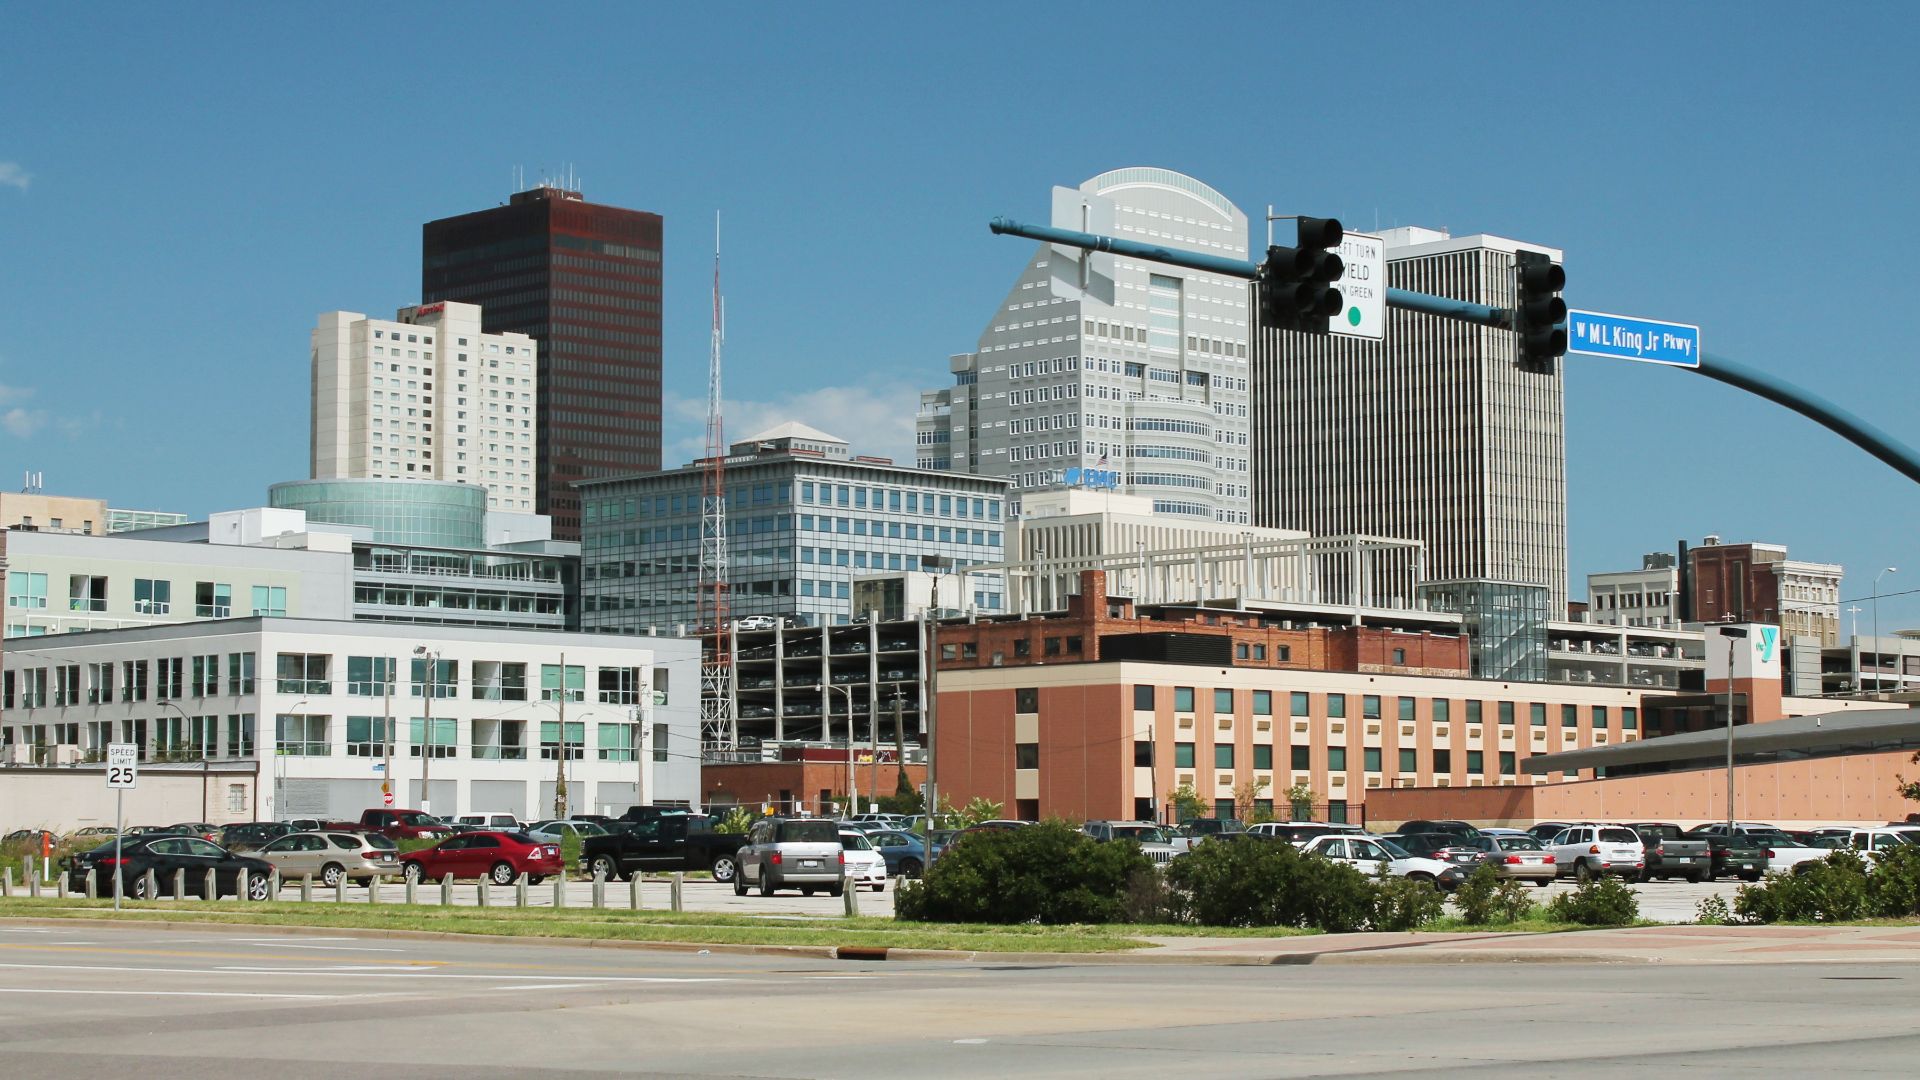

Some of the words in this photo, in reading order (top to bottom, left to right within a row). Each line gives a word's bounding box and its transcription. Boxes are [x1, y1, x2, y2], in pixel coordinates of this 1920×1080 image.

[1356, 243, 1376, 259] TURN
[1350, 285, 1373, 299] GREEN
[1576, 321, 1586, 338] W
[1613, 326, 1642, 356] King
[1645, 330, 1659, 352] Jr
[1663, 333, 1691, 357] Pkwy
[111, 749, 135, 757] SPEED
[110, 767, 134, 783] 25
